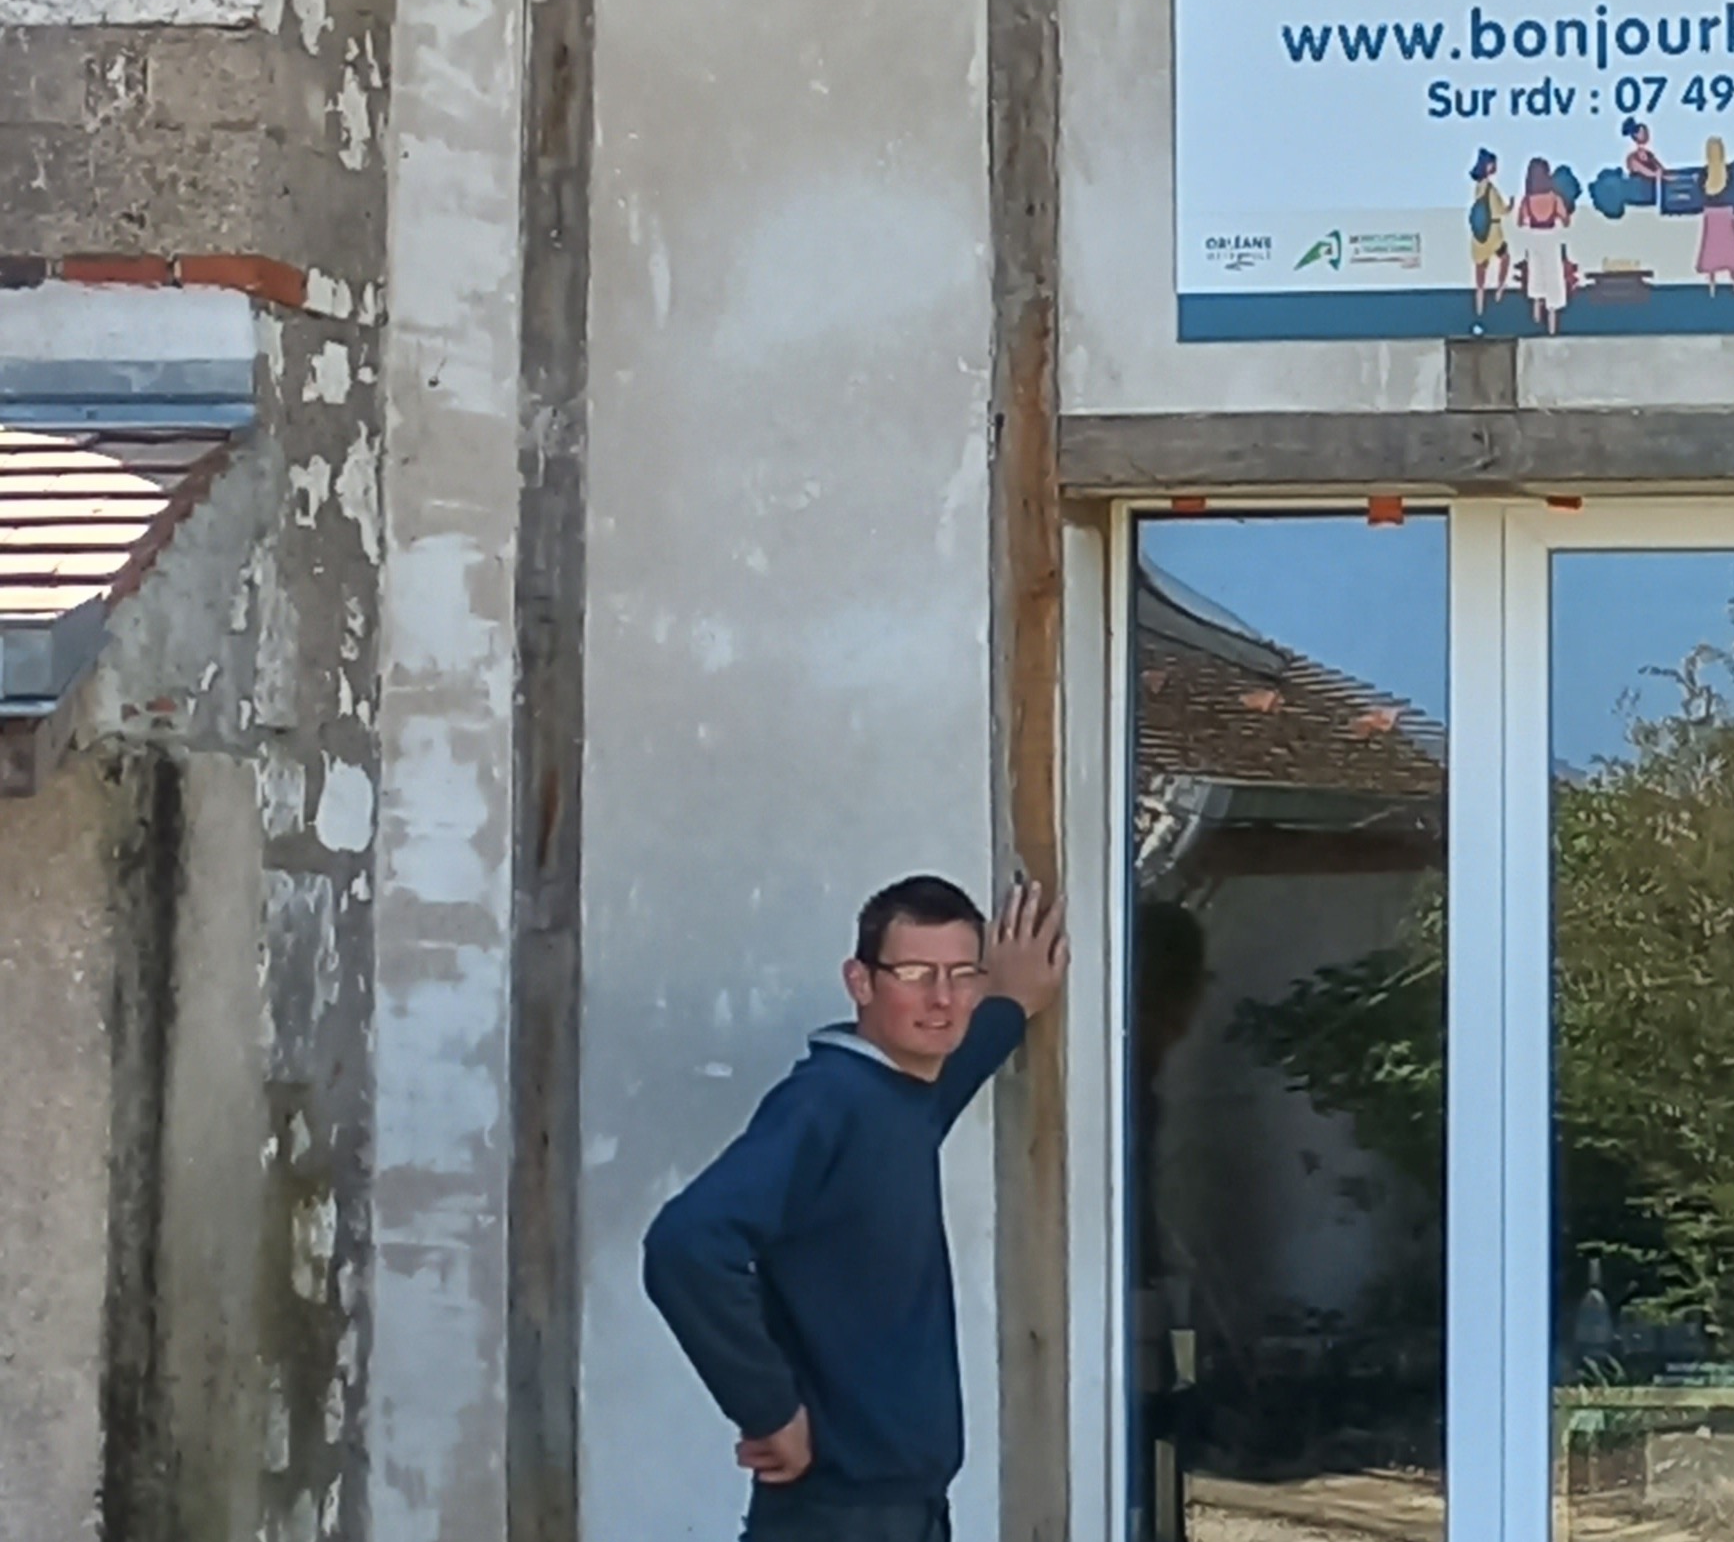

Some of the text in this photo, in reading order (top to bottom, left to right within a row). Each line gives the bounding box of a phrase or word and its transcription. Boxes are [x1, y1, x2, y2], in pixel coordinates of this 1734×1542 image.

[1427, 80, 1497, 118] Sur
[1509, 76, 1576, 116] rdv
[1614, 75, 1668, 114] 07
